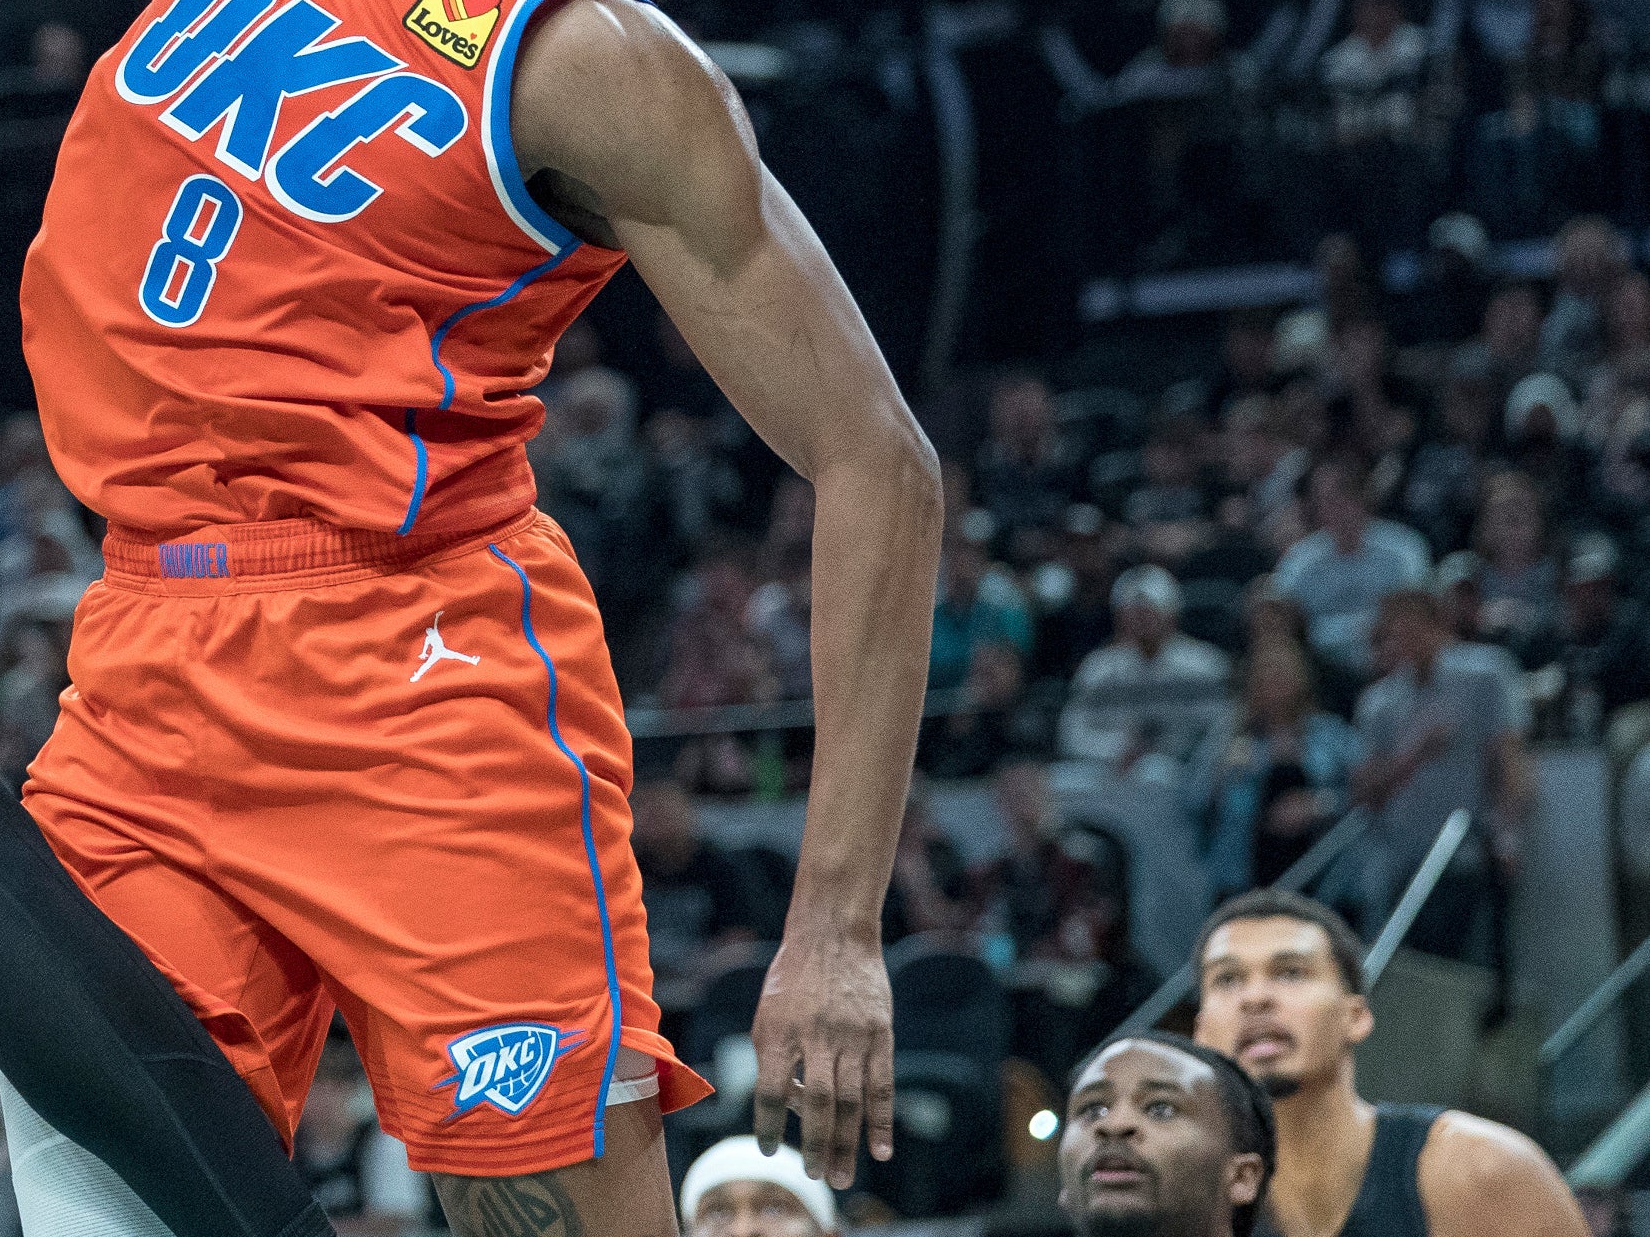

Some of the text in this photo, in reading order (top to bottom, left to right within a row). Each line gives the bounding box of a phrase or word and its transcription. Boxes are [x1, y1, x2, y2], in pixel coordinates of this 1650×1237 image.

[138, 173, 244, 328] 8
[158, 542, 230, 579] THUNDER
[459, 1036, 537, 1102] OKC
